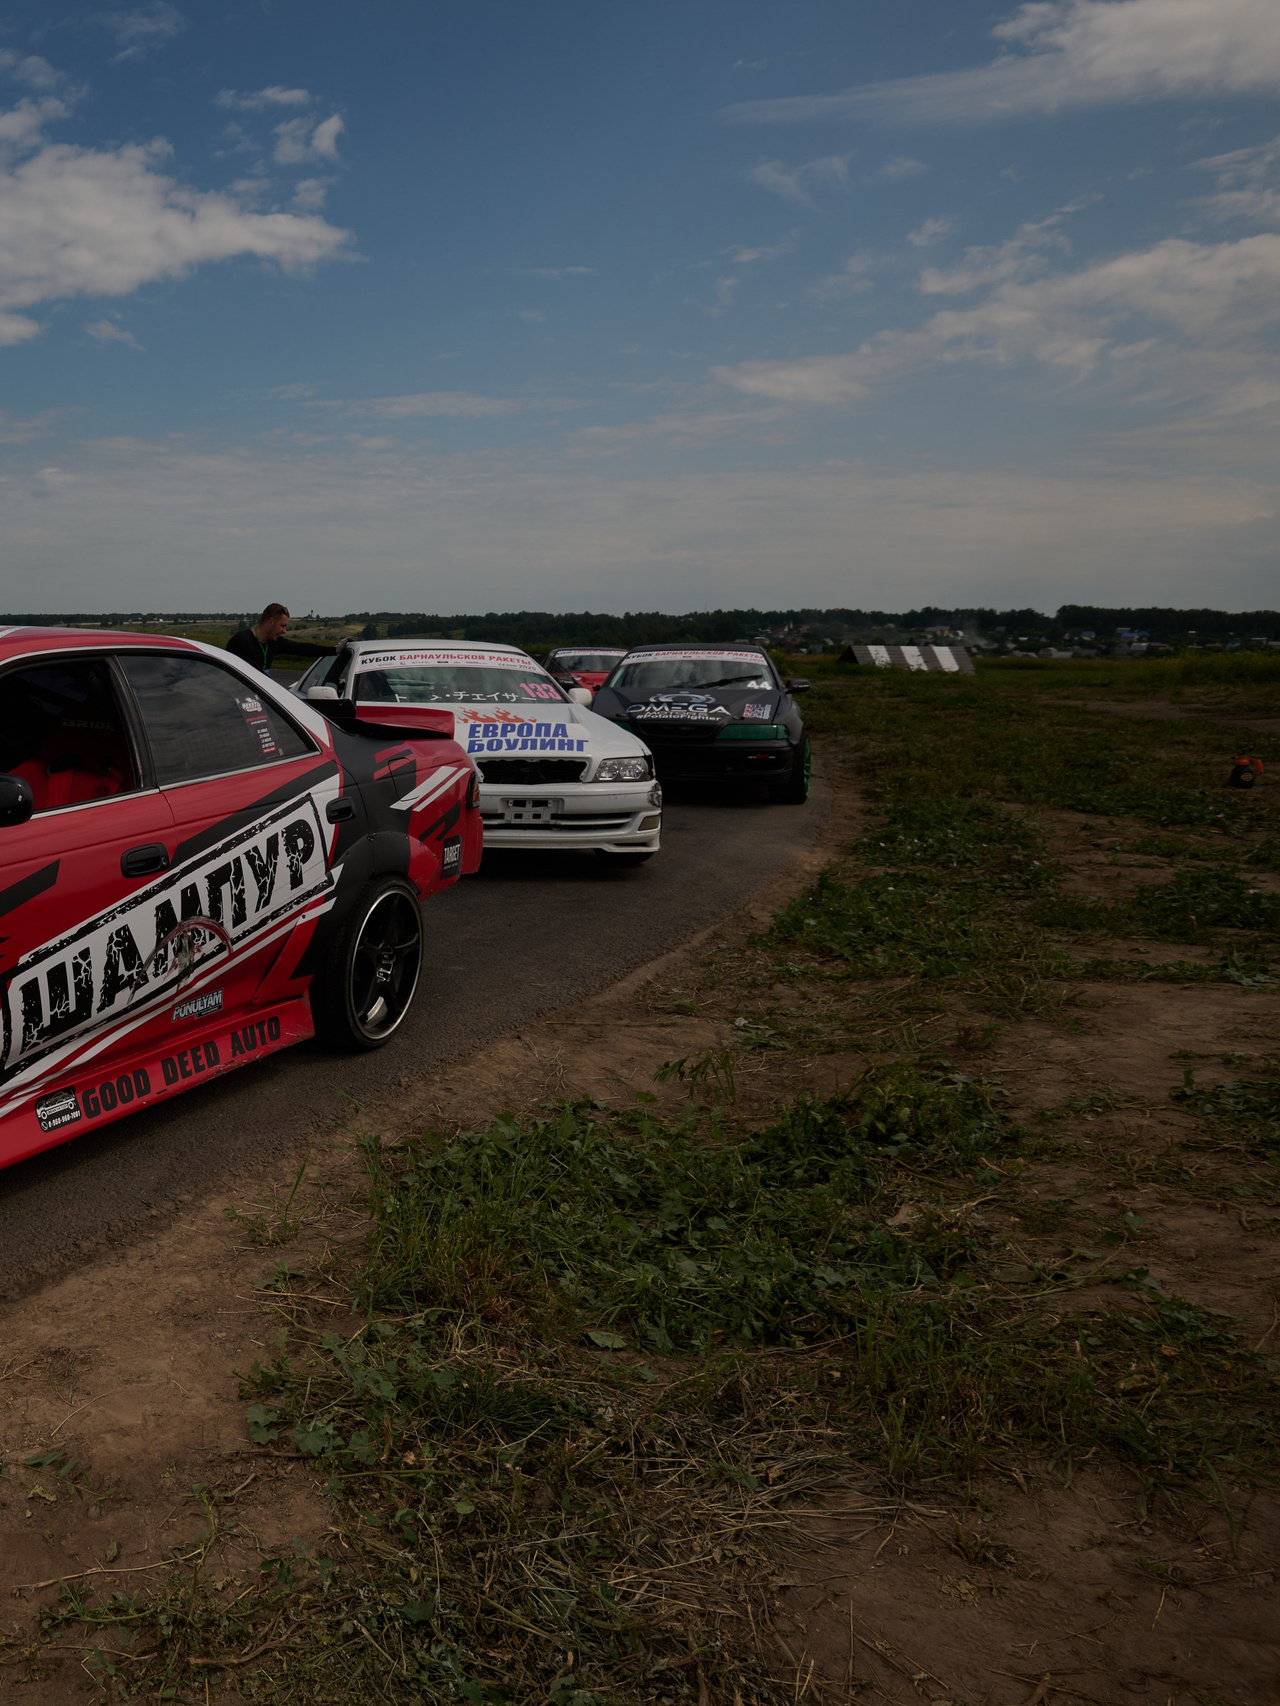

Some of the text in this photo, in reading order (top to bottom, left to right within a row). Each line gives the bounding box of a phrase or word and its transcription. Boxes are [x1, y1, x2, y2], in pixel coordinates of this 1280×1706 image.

[361, 655, 396, 665] КУБОК
[399, 653, 485, 661] БАРНАУЛЬСКОЙ
[488, 655, 531, 665] РАКЕТЫ
[520, 682, 561, 700] 133
[747, 679, 773, 691] 44
[626, 702, 731, 716] OMEGA
[636, 713, 721, 721] #PotatoFighter
[468, 722, 568, 739] ЕВРОПА
[467, 739, 589, 754] БОУЛИНГ
[19, 818, 316, 1056] ШАМПУР
